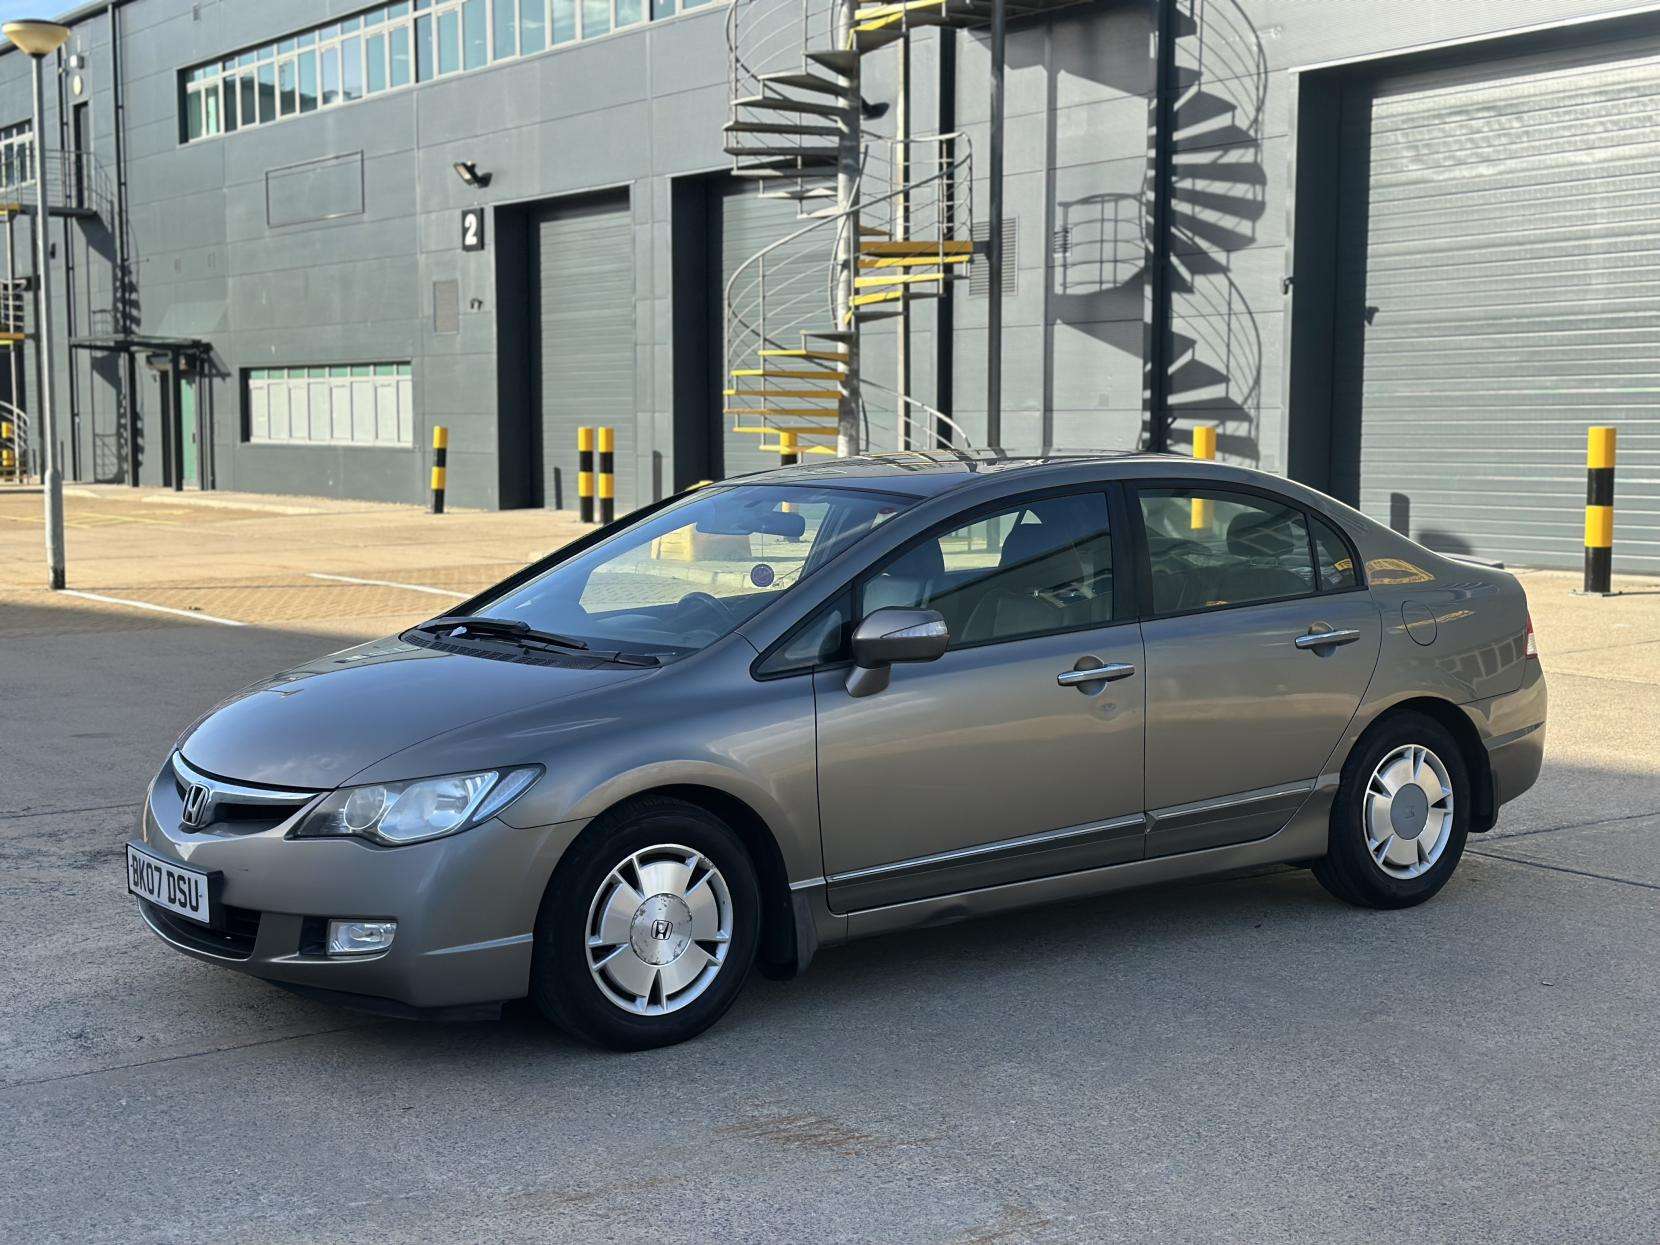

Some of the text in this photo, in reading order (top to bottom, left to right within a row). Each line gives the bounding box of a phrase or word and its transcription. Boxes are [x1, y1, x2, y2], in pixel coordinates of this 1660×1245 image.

[464, 213, 478, 246] 2
[131, 853, 199, 912] BK07 DSU
